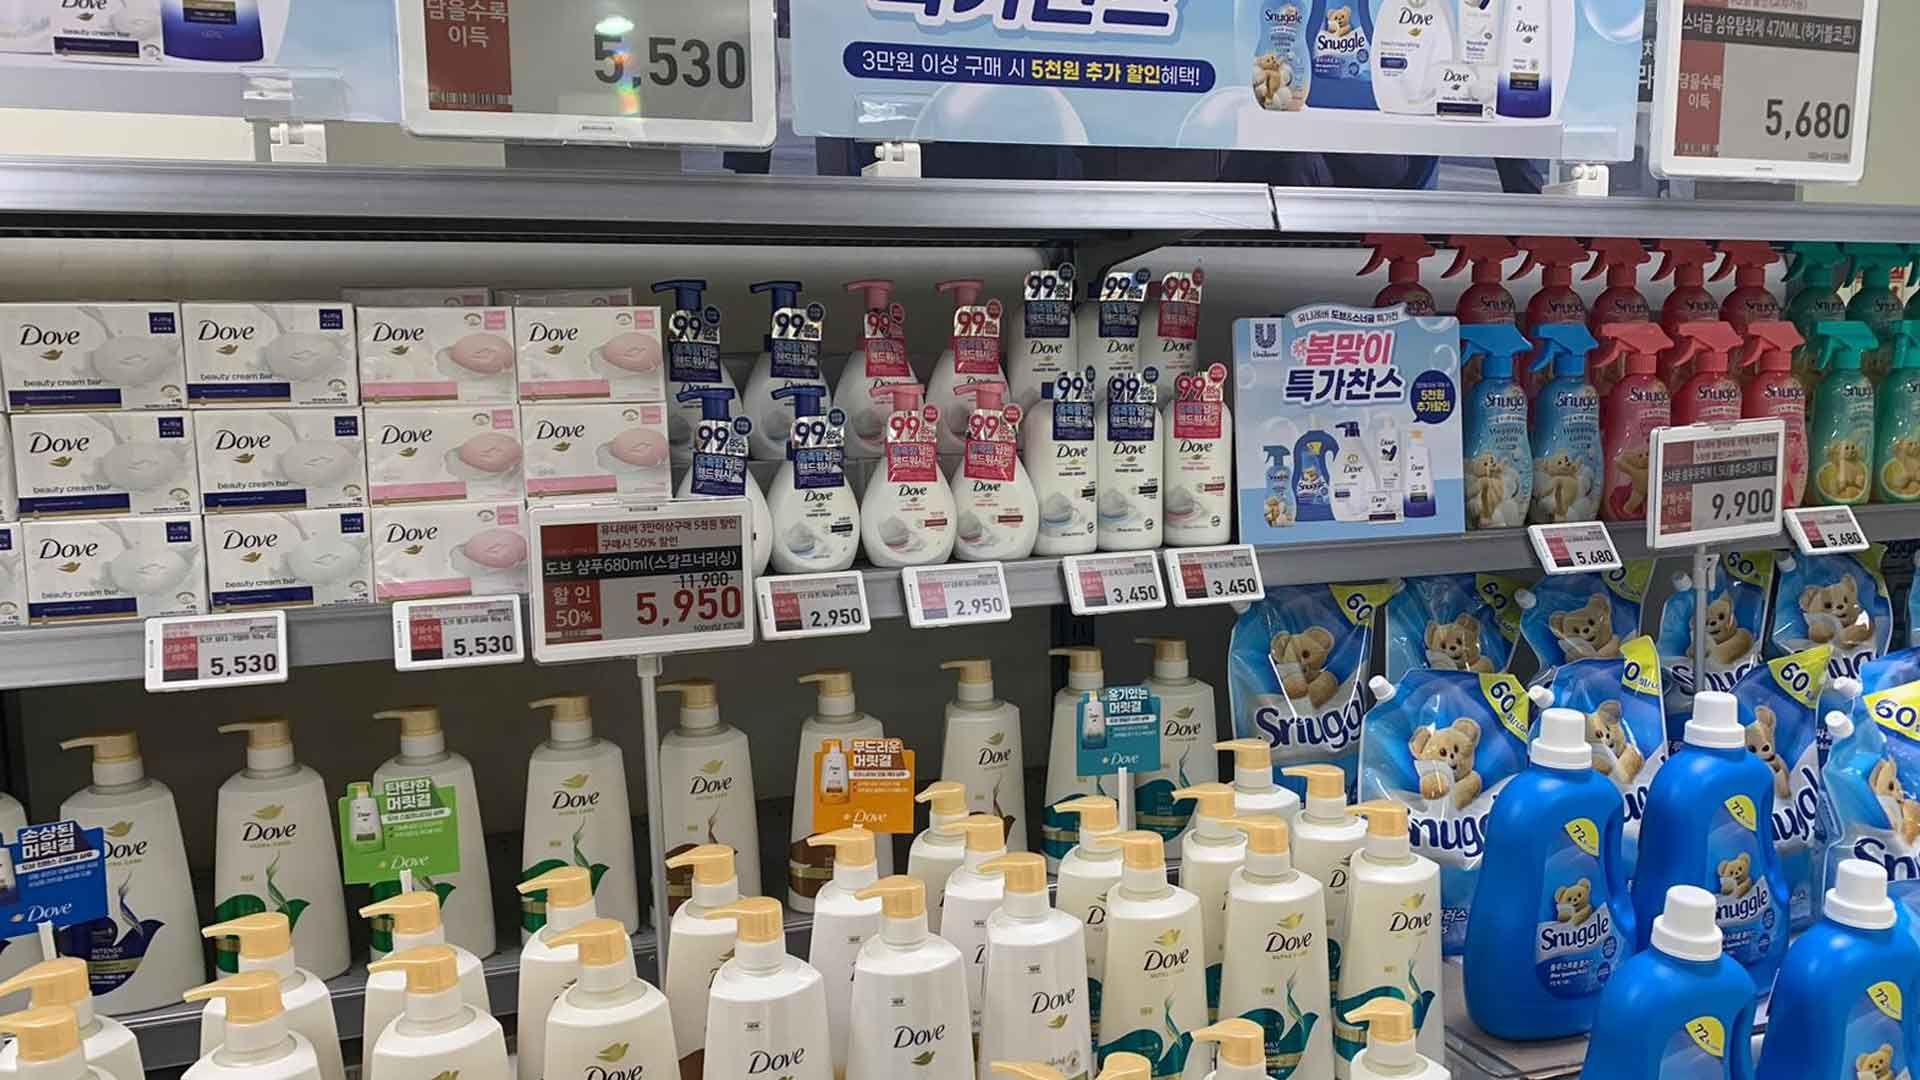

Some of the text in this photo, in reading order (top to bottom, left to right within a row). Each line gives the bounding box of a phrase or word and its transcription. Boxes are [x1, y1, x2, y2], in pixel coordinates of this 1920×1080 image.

[1399, 7, 1434, 25] Dove
[448, 25, 489, 48] 이득
[1317, 32, 1365, 53] Snuggle
[594, 34, 746, 89] 5,530
[862, 50, 1200, 87] 3만원 이상 구매 시 5천원 추가 할인혜택!
[1688, 93, 1712, 110] 이득
[1765, 98, 1850, 140] 5,680
[20, 324, 81, 346] Dove
[198, 319, 255, 341] Dove
[373, 322, 425, 342] Dove
[529, 322, 578, 342] Dove
[1305, 332, 1393, 366] 봄맞이
[24, 379, 55, 388] beauty
[1057, 377, 1084, 400] 99
[1111, 377, 1141, 401] 99
[1175, 375, 1206, 401] 99
[1286, 368, 1403, 402] 특가찬스
[381, 424, 433, 444] Dove
[536, 420, 585, 440] Dove
[795, 421, 826, 447] 99
[890, 416, 920, 439] 99
[970, 415, 1000, 438] 99
[30, 432, 90, 453] Dove
[215, 429, 271, 450] Dove
[698, 425, 729, 452] 99
[1112, 440, 1147, 455] Dove
[1178, 439, 1213, 453] Dove
[1056, 444, 1089, 458] Dove
[33, 486, 65, 495] beauty
[217, 481, 249, 490] beauty
[898, 484, 928, 496] Dove
[973, 481, 1001, 492] Dove
[804, 491, 834, 502] Dove
[1712, 487, 1774, 521] 9,900
[223, 530, 278, 549] Dove
[385, 523, 439, 544] Dove
[633, 537, 657, 549] 50%
[1827, 531, 1862, 546] 5,680
[40, 538, 99, 559] Dove
[1576, 550, 1614, 565] 5,680
[545, 559, 573, 576] 도브
[1727, 551, 1755, 575] 60
[225, 580, 256, 589] beauty
[257, 579, 283, 587] cream
[1112, 585, 1159, 604] 3,450
[1213, 578, 1257, 596] 3,450
[637, 586, 741, 627] 5,950
[955, 597, 1003, 617] 2,950
[1346, 592, 1374, 622] 60
[555, 609, 593, 627] 50%
[810, 607, 862, 629] 2,950
[454, 635, 514, 657] 5,530
[210, 653, 277, 677] 5,530
[1780, 662, 1810, 693] 60
[1108, 687, 1149, 701] 윤기있는
[1490, 681, 1516, 714] 60
[1109, 700, 1142, 714] 머릿결
[1874, 699, 1917, 729] 60
[1164, 720, 1201, 736] Dove
[853, 740, 901, 755] 부드러운
[978, 747, 1012, 766] Dove
[853, 754, 892, 768] 머릿결
[1110, 752, 1139, 765] Dove
[385, 778, 432, 796] 탄탄한
[689, 775, 734, 795] Dove
[386, 793, 432, 811] 머릿결
[551, 789, 600, 810] Dove
[1731, 801, 1745, 818] 72
[21, 823, 75, 845] 손상된
[242, 821, 297, 842] Dove
[1573, 825, 1588, 842] 72
[22, 838, 75, 859] 머릿결
[104, 840, 148, 859] Dove
[27, 903, 73, 922] Dove
[1716, 886, 1769, 920] nuggle
[1389, 911, 1433, 932] Dove
[1541, 913, 1610, 951] Snuggle
[1265, 931, 1313, 954] Dove
[1143, 947, 1190, 972] Dove
[1031, 988, 1076, 1015] Dove
[1874, 987, 1889, 1006] 72
[893, 1023, 945, 1049] Dove
[1695, 1023, 1710, 1042] 72
[749, 1047, 805, 1075] Dove
